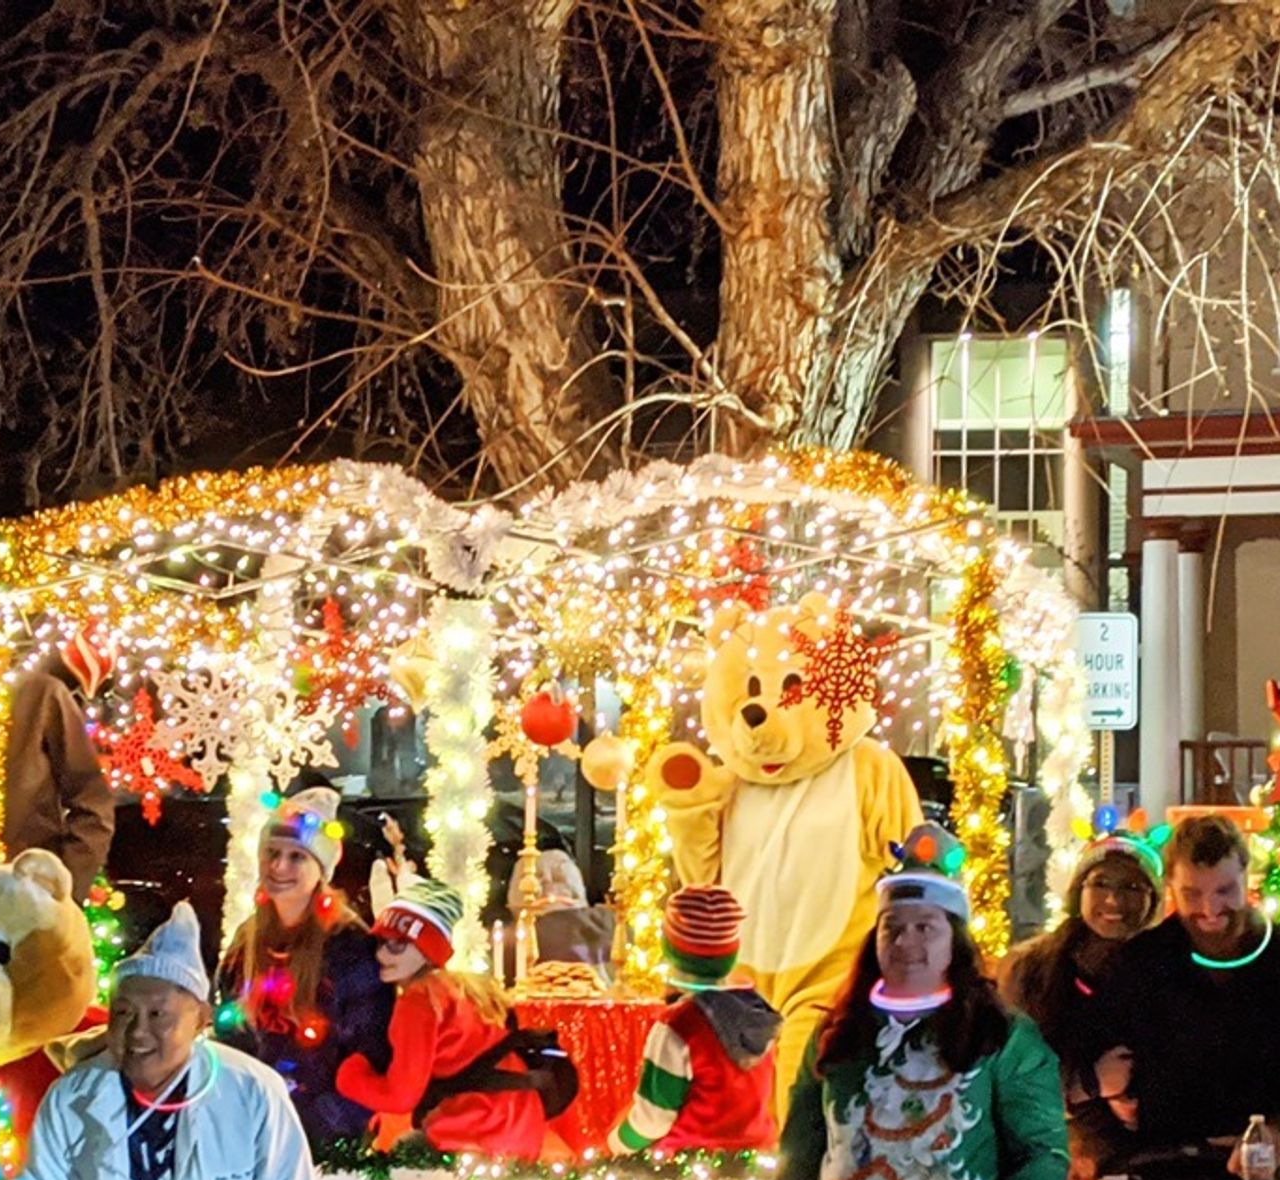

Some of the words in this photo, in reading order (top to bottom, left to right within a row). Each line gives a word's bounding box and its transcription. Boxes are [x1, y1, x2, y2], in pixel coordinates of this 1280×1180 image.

[1100, 622, 1109, 642] 2
[1084, 652, 1125, 671] HOUR
[1087, 682, 1131, 699] ARKING
